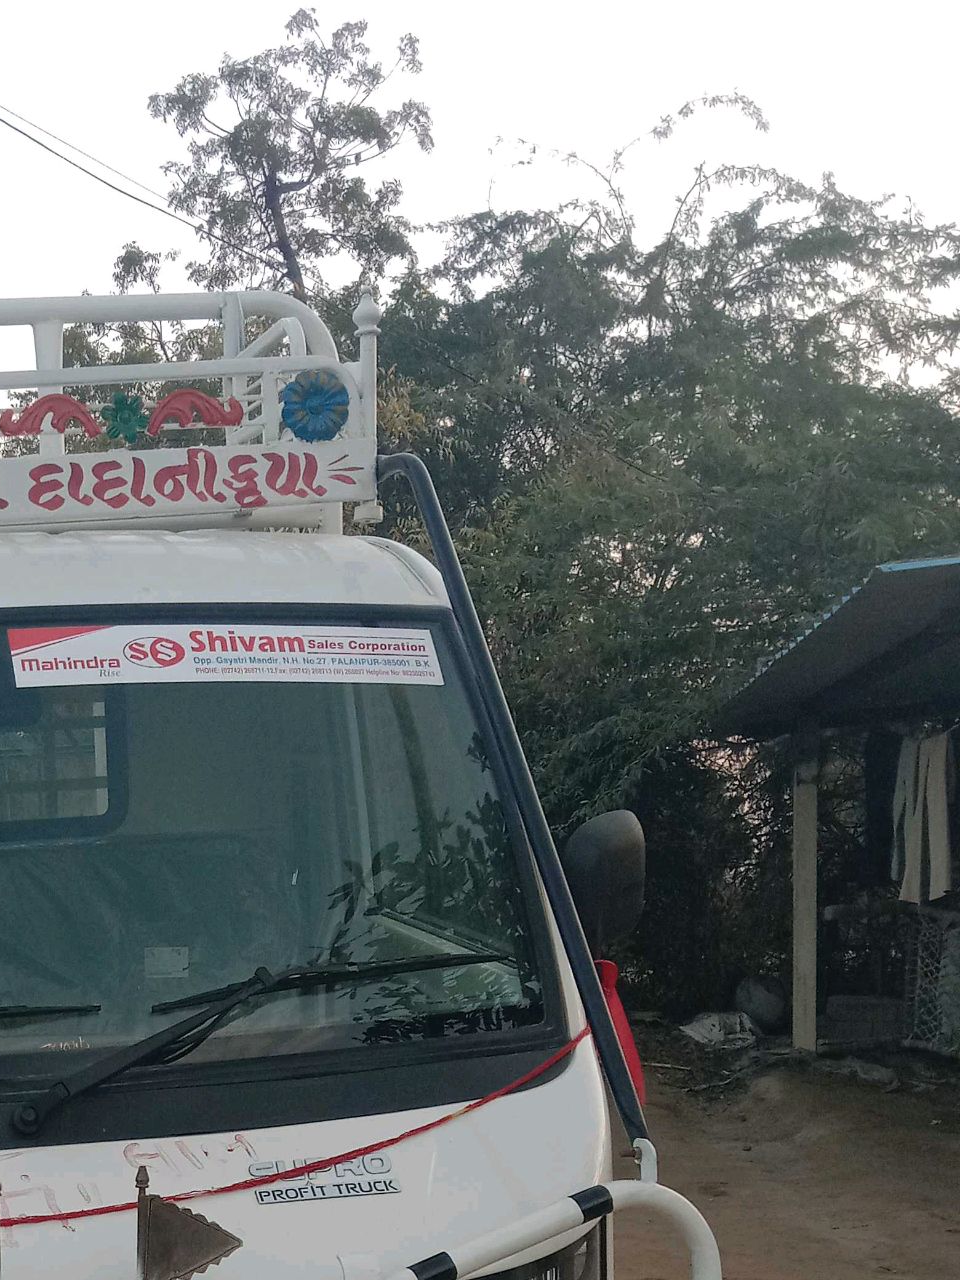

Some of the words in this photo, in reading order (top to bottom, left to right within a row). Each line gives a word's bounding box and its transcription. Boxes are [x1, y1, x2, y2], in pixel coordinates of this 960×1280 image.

[189, 630, 306, 653] Shivam
[308, 639, 344, 650] Sales
[348, 640, 427, 652] Corporation
[21, 656, 121, 672] Mahindra
[216, 656, 247, 666] Gayatri
[99, 668, 121, 678] Rise
[258, 1184, 328, 1202] PROFIT
[332, 1180, 397, 1196] TRUCK
